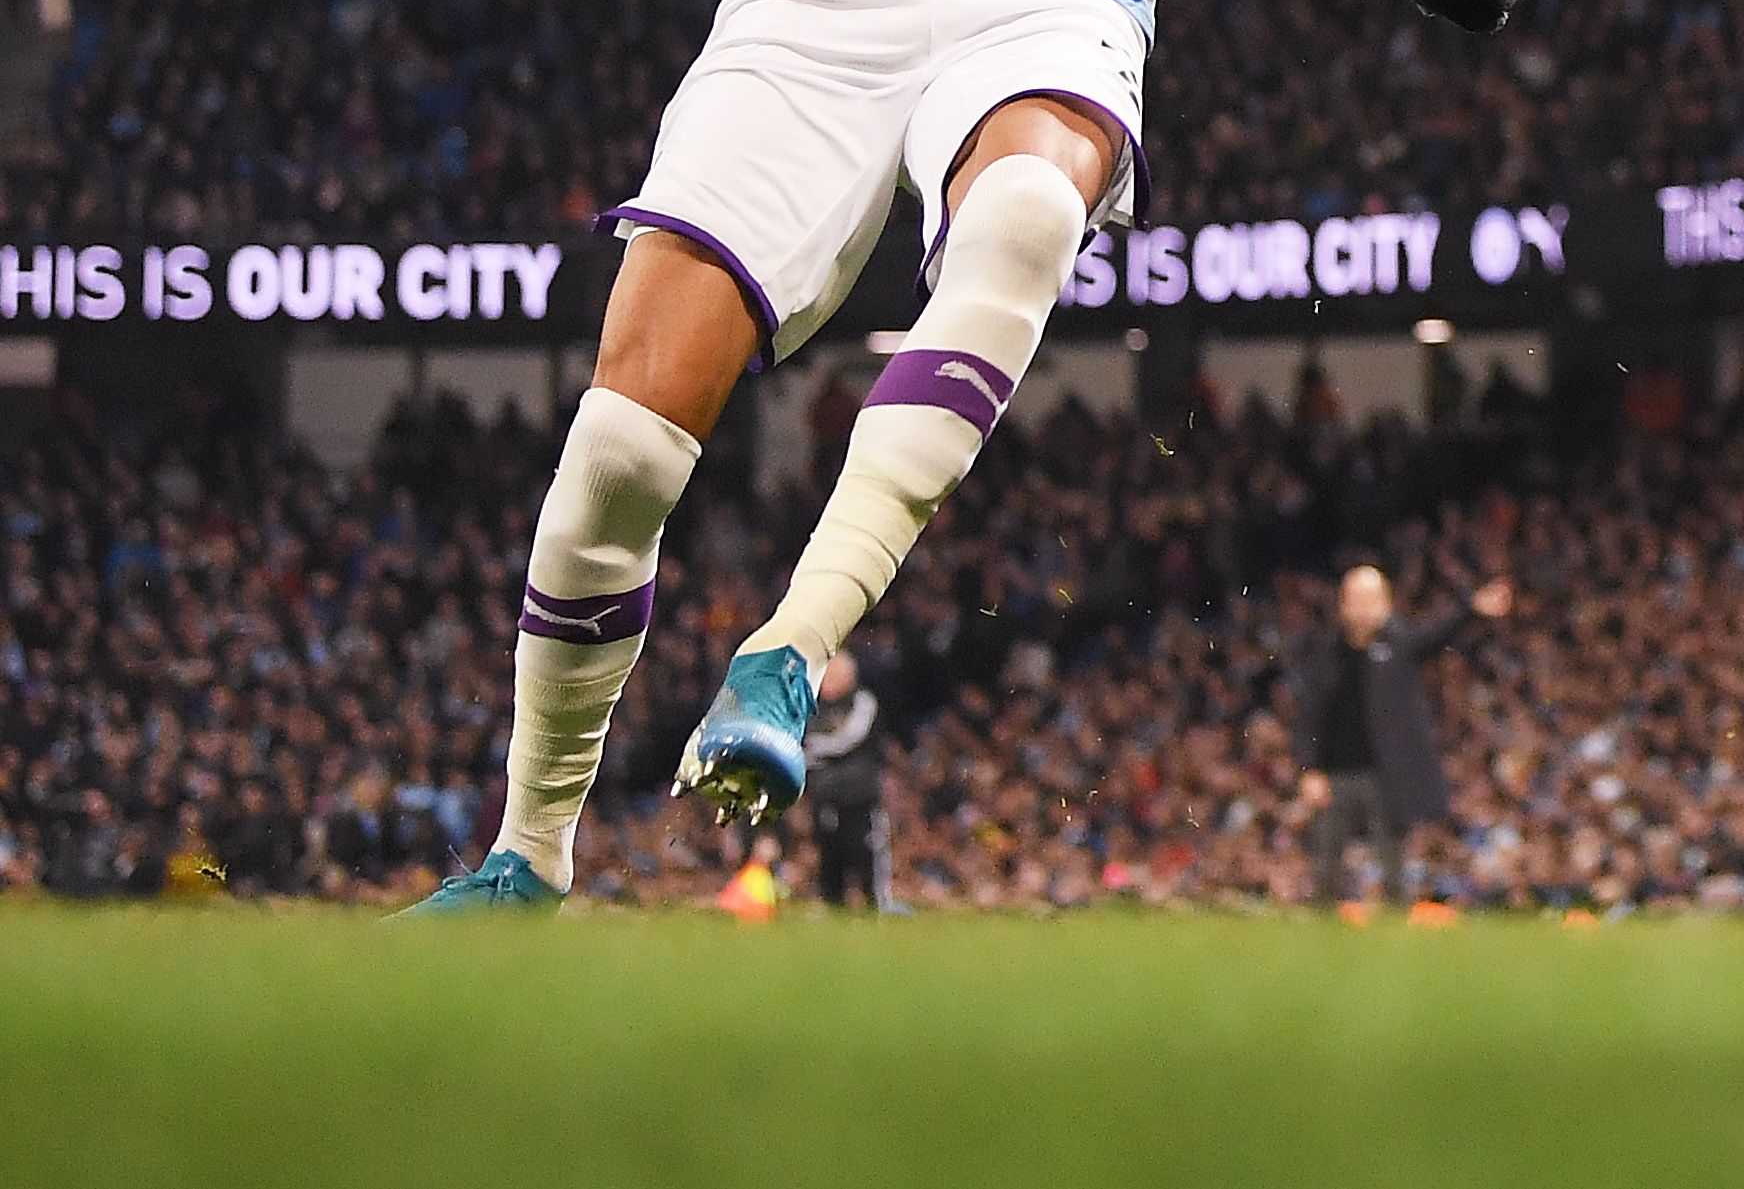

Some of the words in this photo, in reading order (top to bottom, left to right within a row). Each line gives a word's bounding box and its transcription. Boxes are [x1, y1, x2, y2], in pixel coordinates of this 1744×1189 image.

[0, 245, 126, 321] HIS
[143, 244, 213, 321] IS
[226, 244, 385, 321] OUR
[397, 244, 562, 321] CITY
[1126, 226, 1189, 305] IS
[1193, 220, 1311, 303] OUR
[1313, 213, 1441, 295] CITY
